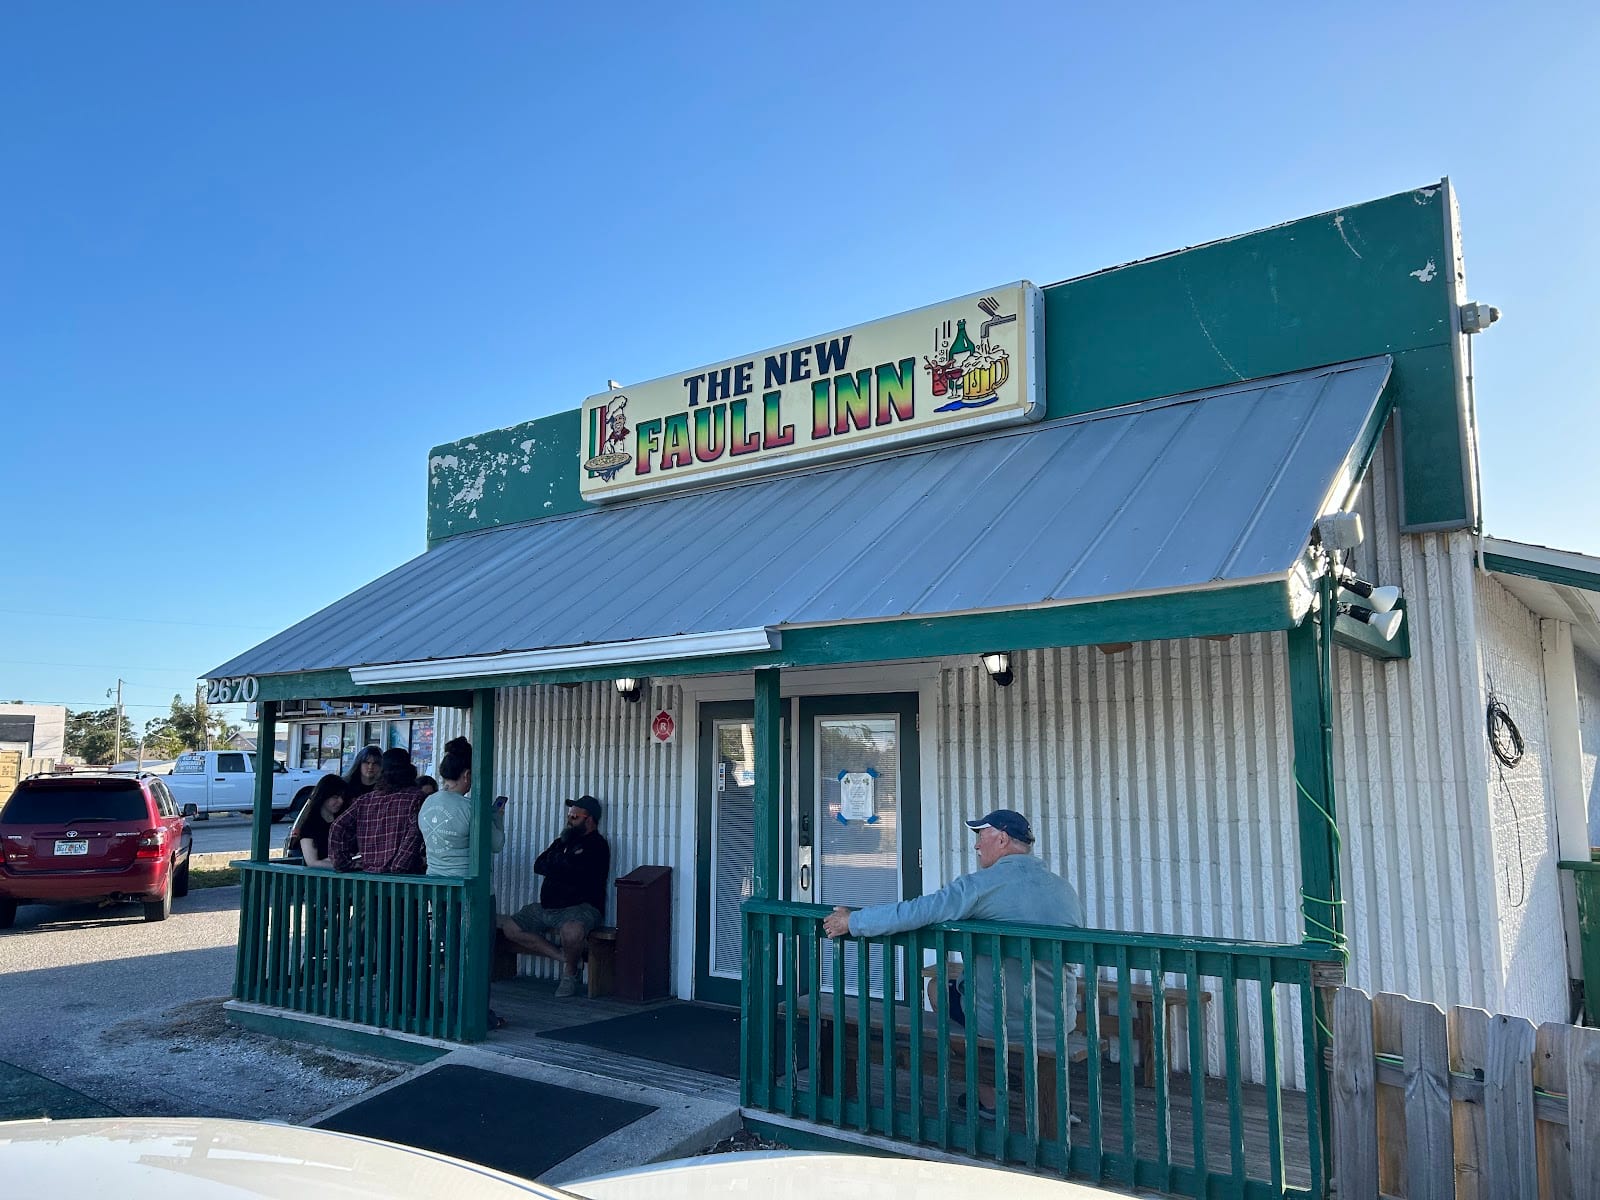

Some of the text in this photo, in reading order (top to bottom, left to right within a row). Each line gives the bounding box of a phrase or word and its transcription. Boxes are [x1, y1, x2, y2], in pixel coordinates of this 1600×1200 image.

[683, 335, 852, 407] THE NEW
[635, 357, 916, 475] FAULL INN
[207, 676, 259, 703] 2670
